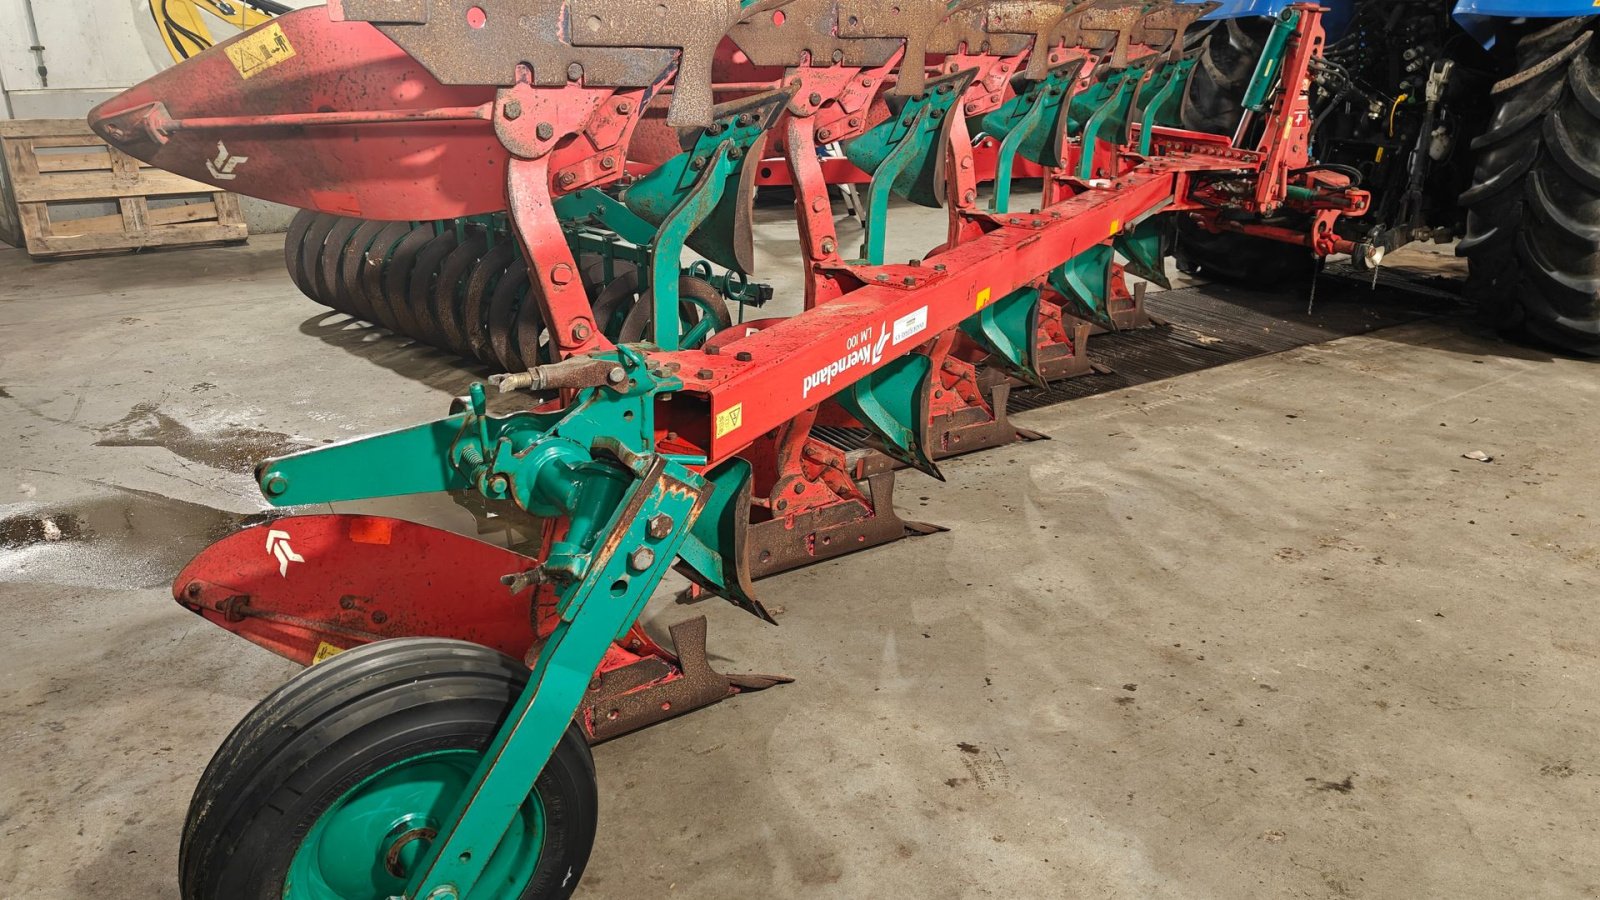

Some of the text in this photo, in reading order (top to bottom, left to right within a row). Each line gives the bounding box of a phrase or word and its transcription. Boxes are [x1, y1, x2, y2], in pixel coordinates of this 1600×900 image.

[846, 327, 872, 350] LM 100
[803, 344, 871, 399] Kverneland
